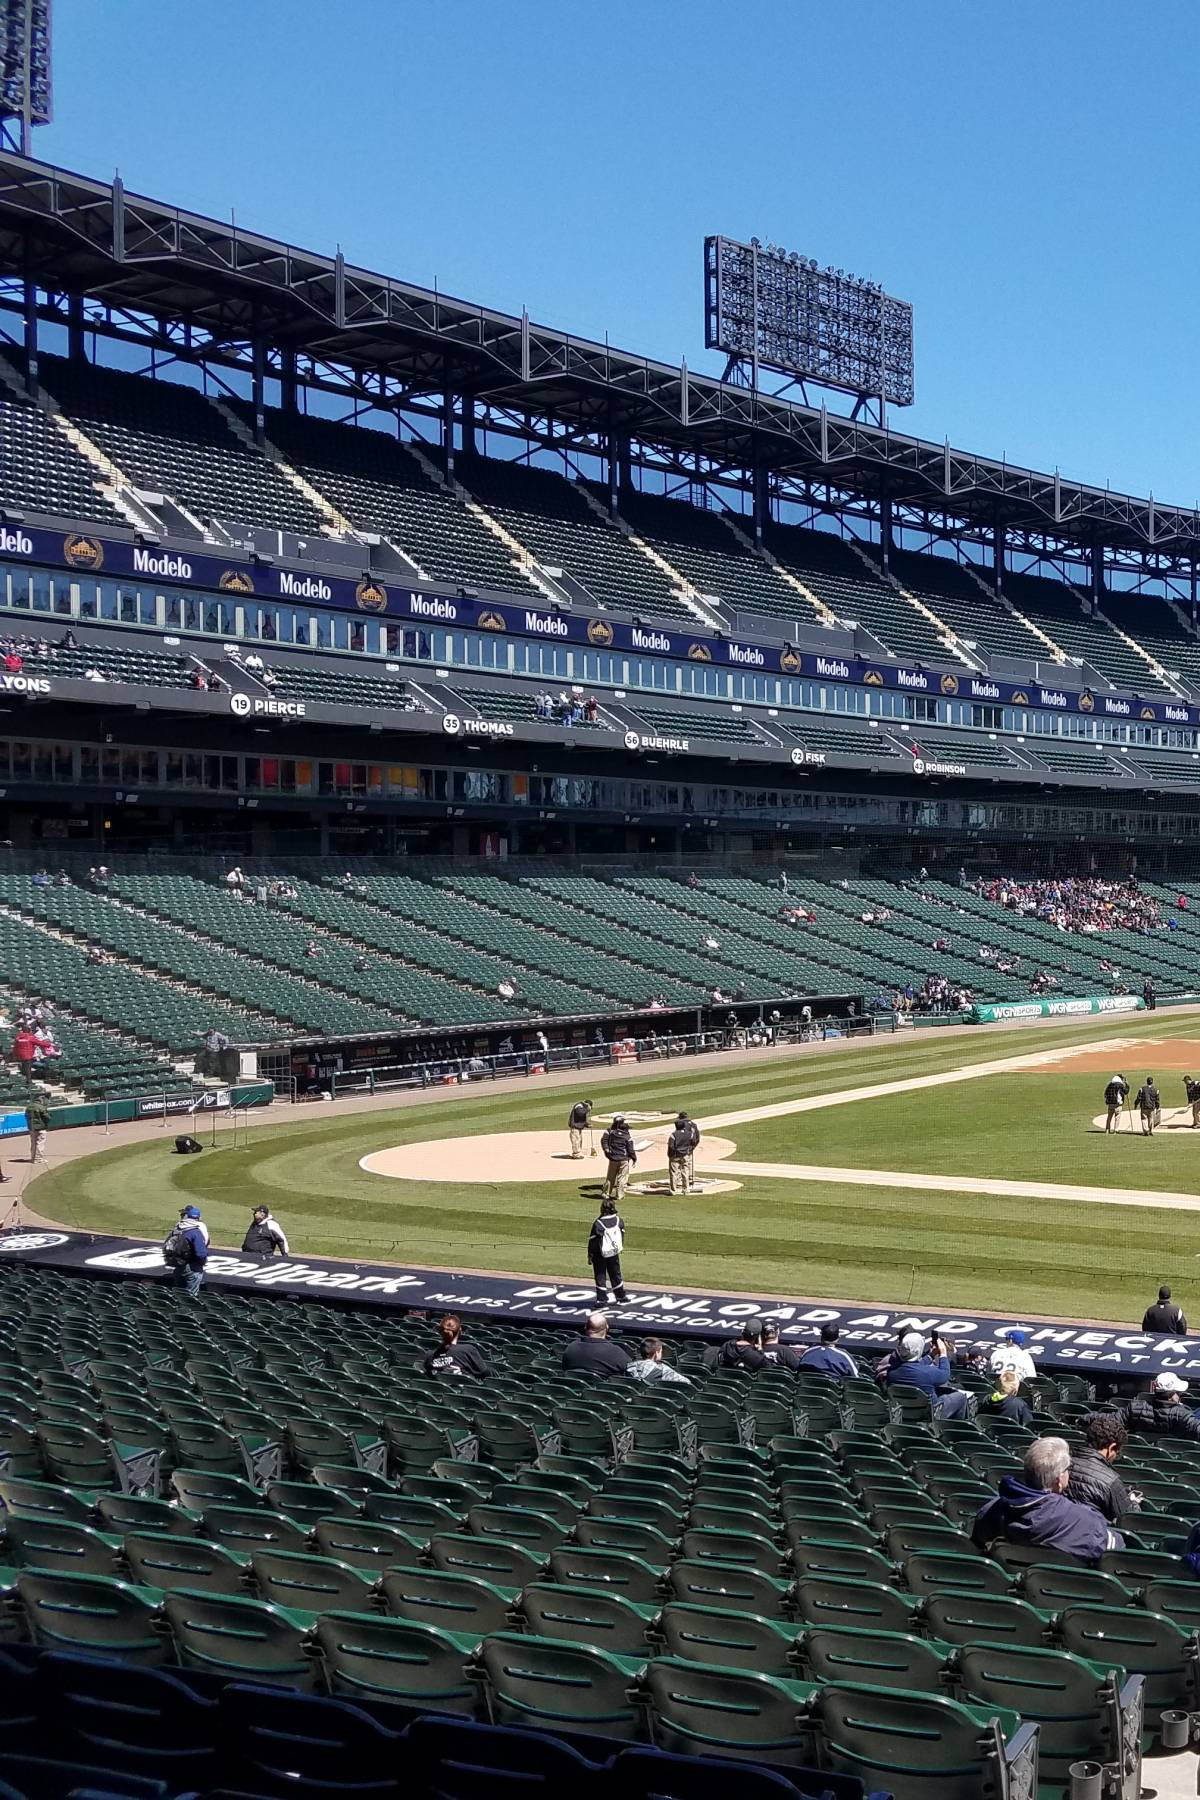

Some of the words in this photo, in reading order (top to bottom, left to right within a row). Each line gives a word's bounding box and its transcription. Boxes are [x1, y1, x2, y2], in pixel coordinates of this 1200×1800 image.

[134, 549, 191, 578] Modelo
[281, 573, 331, 600] Modelo
[411, 594, 456, 619] Modelo
[526, 611, 567, 635] Modelo
[632, 629, 670, 651] Modelo
[729, 644, 764, 665] Modelo
[817, 657, 849, 677] Modelo
[898, 669, 927, 688] Modelo
[971, 681, 999, 698] Modelo
[1041, 691, 1067, 706] Modelo
[234, 698, 248, 710] 19
[254, 700, 305, 716] PIERCE
[1105, 699, 1130, 714] Modelo
[1165, 706, 1189, 721] Modelo
[463, 719, 514, 735] THOMAS
[626, 734, 637, 746] 56
[641, 736, 689, 750] BUEHRLE
[805, 753, 826, 763] FISK
[926, 767, 966, 775] ROBINSON
[992, 1007, 1015, 1018] WGN
[1016, 1006, 1042, 1015] SPORTS
[1048, 1003, 1070, 1013] WGN
[1071, 1002, 1092, 1012] SPORTS
[1098, 1000, 1117, 1010] WGN
[203, 1256, 426, 1293] Ballpark
[424, 1293, 511, 1308] MAPS
[1056, 1348, 1151, 1364] SEAT
[847, 1314, 978, 1334] AND
